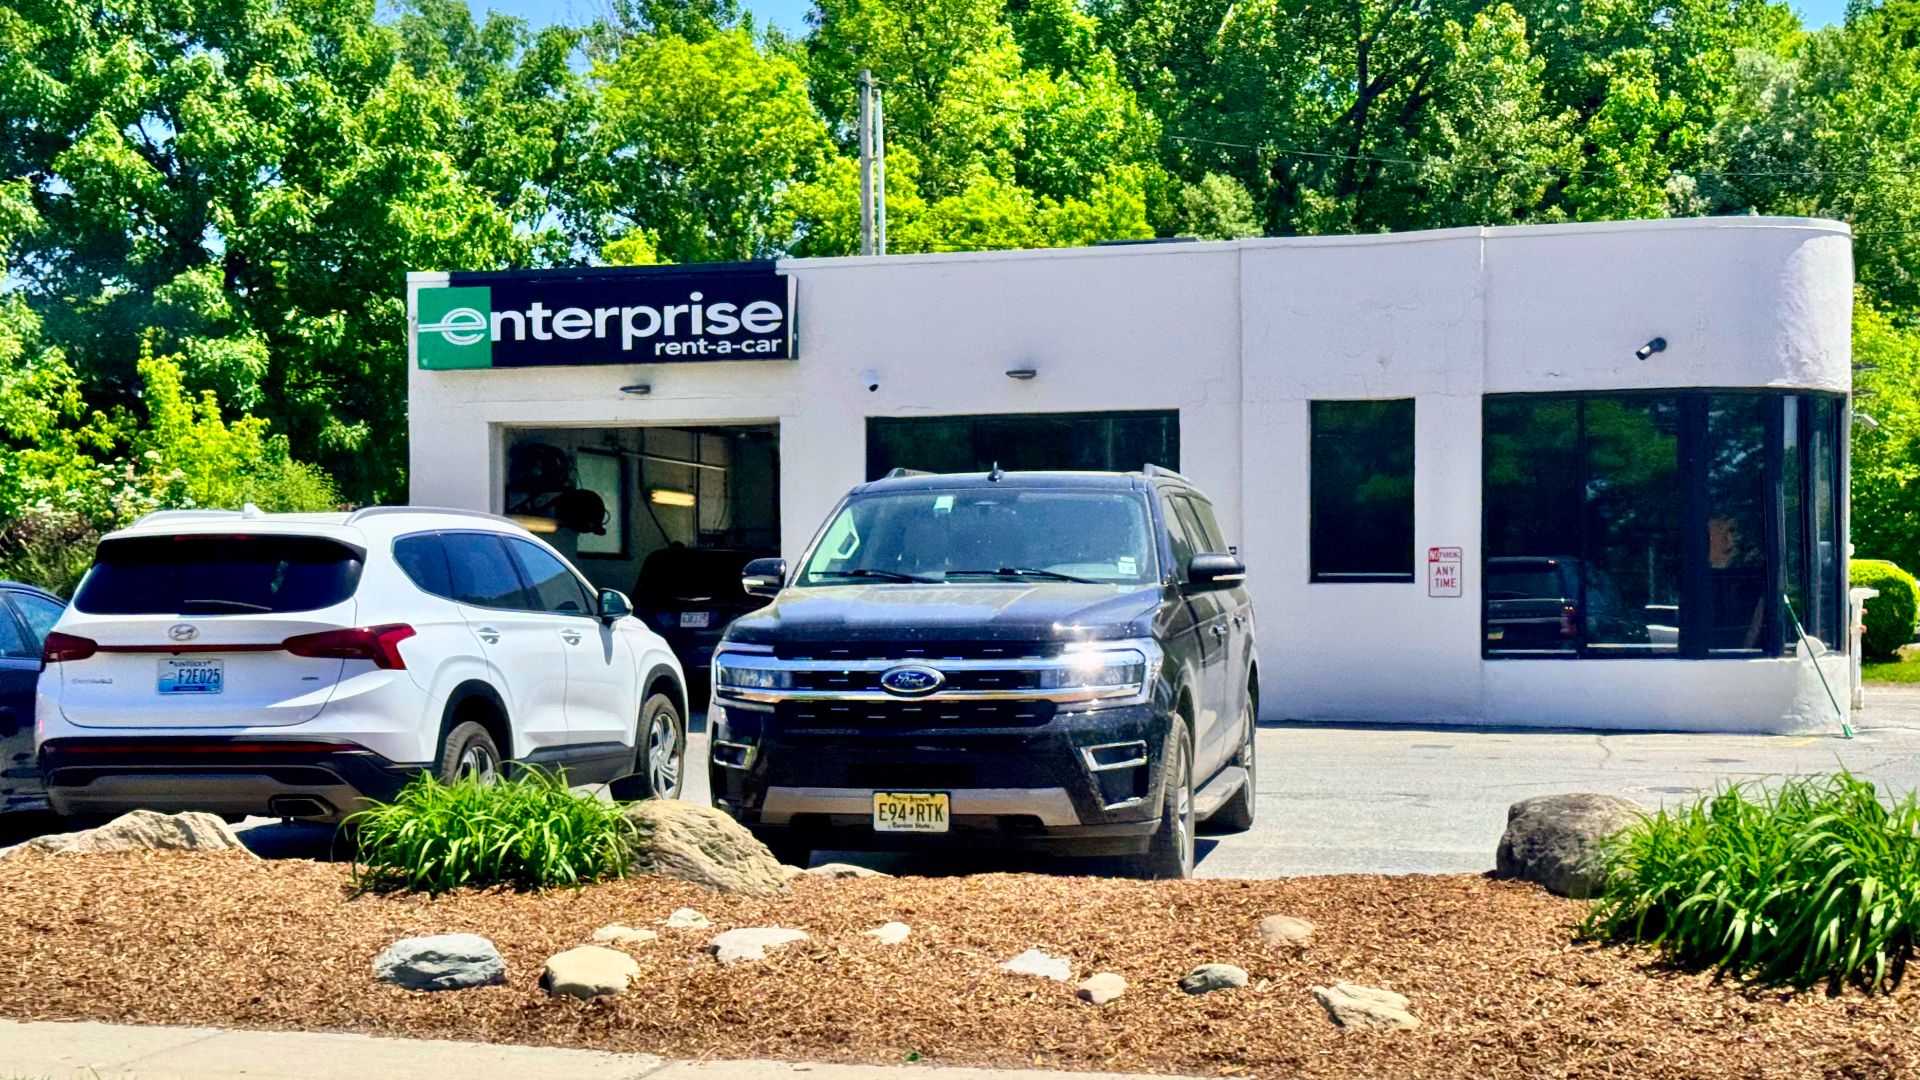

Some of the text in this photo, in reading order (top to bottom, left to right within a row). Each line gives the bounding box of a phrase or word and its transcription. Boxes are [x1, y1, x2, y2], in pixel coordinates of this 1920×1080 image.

[418, 292, 783, 350] enterprise
[655, 337, 782, 356] rent-a-car
[1435, 566, 1455, 576] ANY
[1434, 578, 1456, 588] TIME
